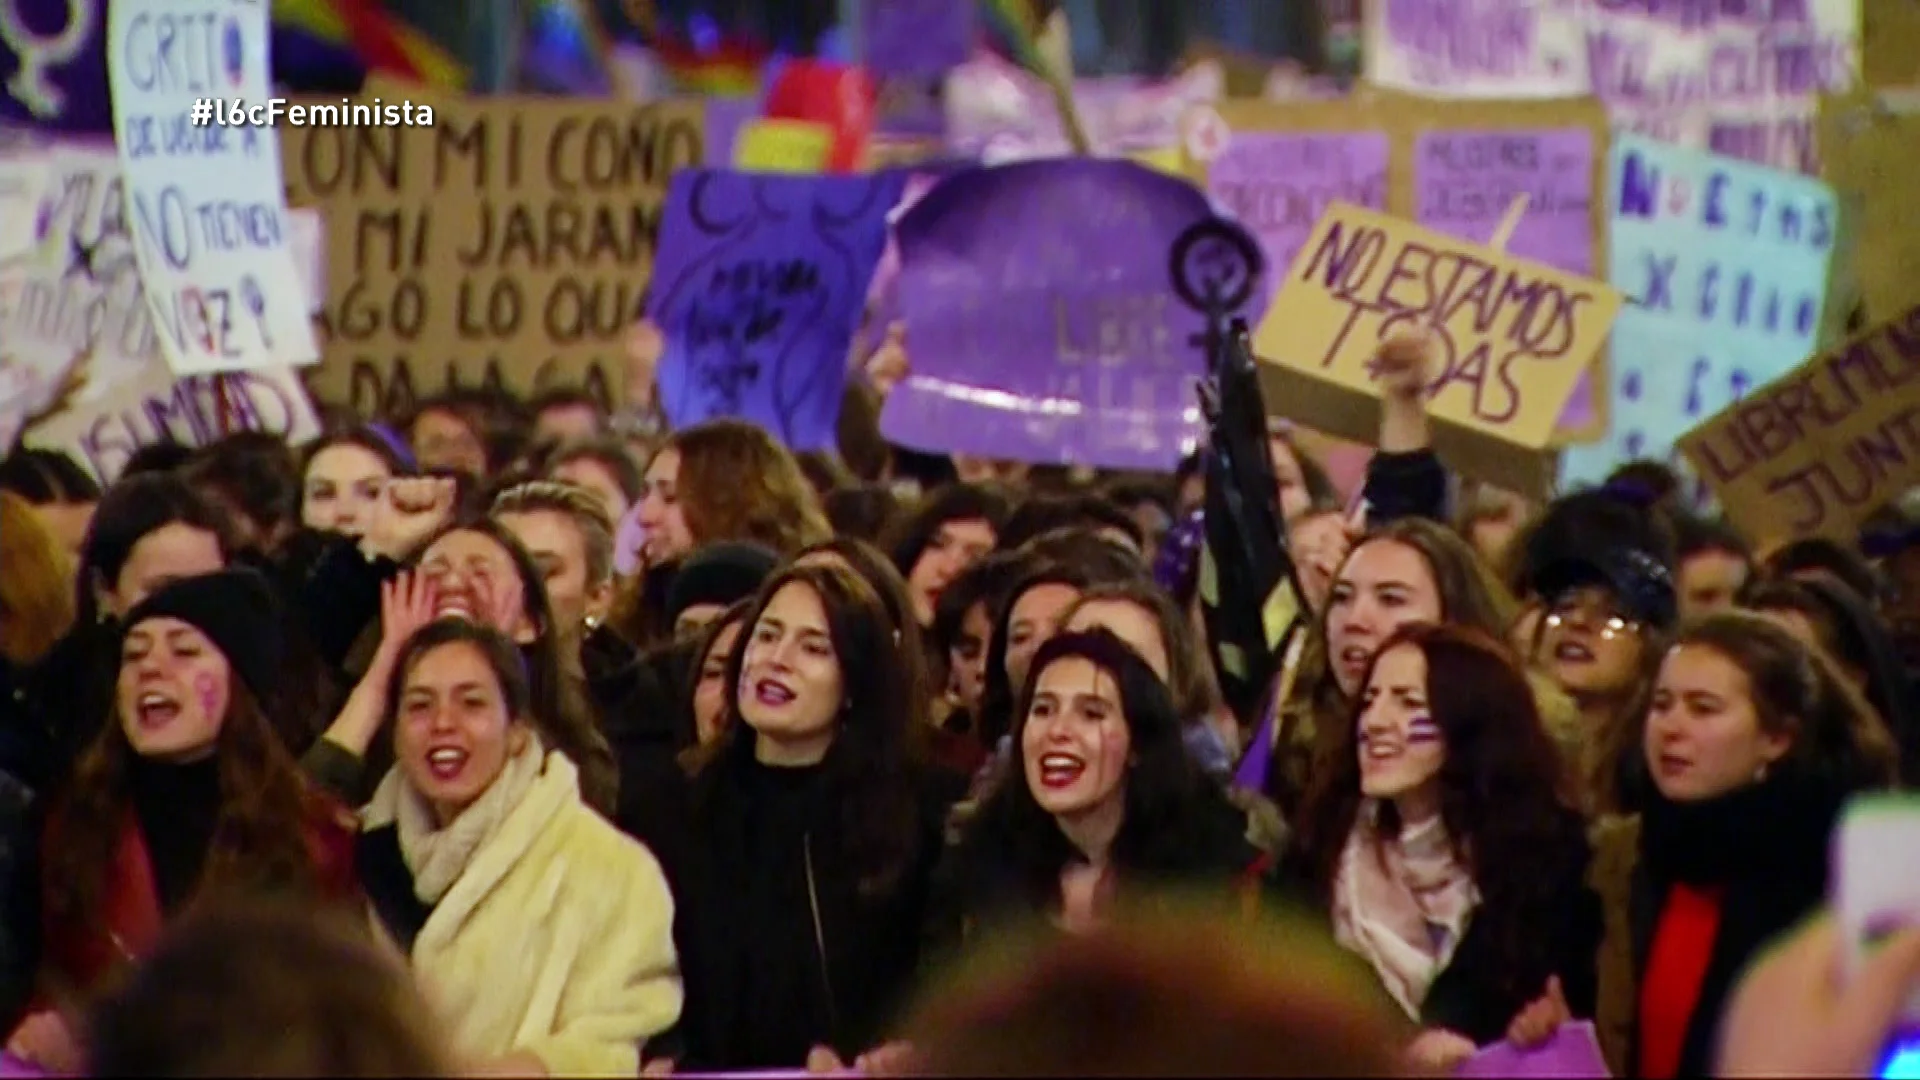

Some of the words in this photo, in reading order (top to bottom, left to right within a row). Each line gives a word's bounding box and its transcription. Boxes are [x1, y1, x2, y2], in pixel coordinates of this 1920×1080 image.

[124, 10, 244, 94] GRITO
[433, 113, 524, 191] MI
[546, 103, 701, 195] COÑO
[134, 184, 190, 271] NO
[355, 206, 430, 273] MI
[458, 278, 523, 343] LO
[1302, 221, 1388, 294] NO
[1377, 241, 1594, 359] ESTAMOS
